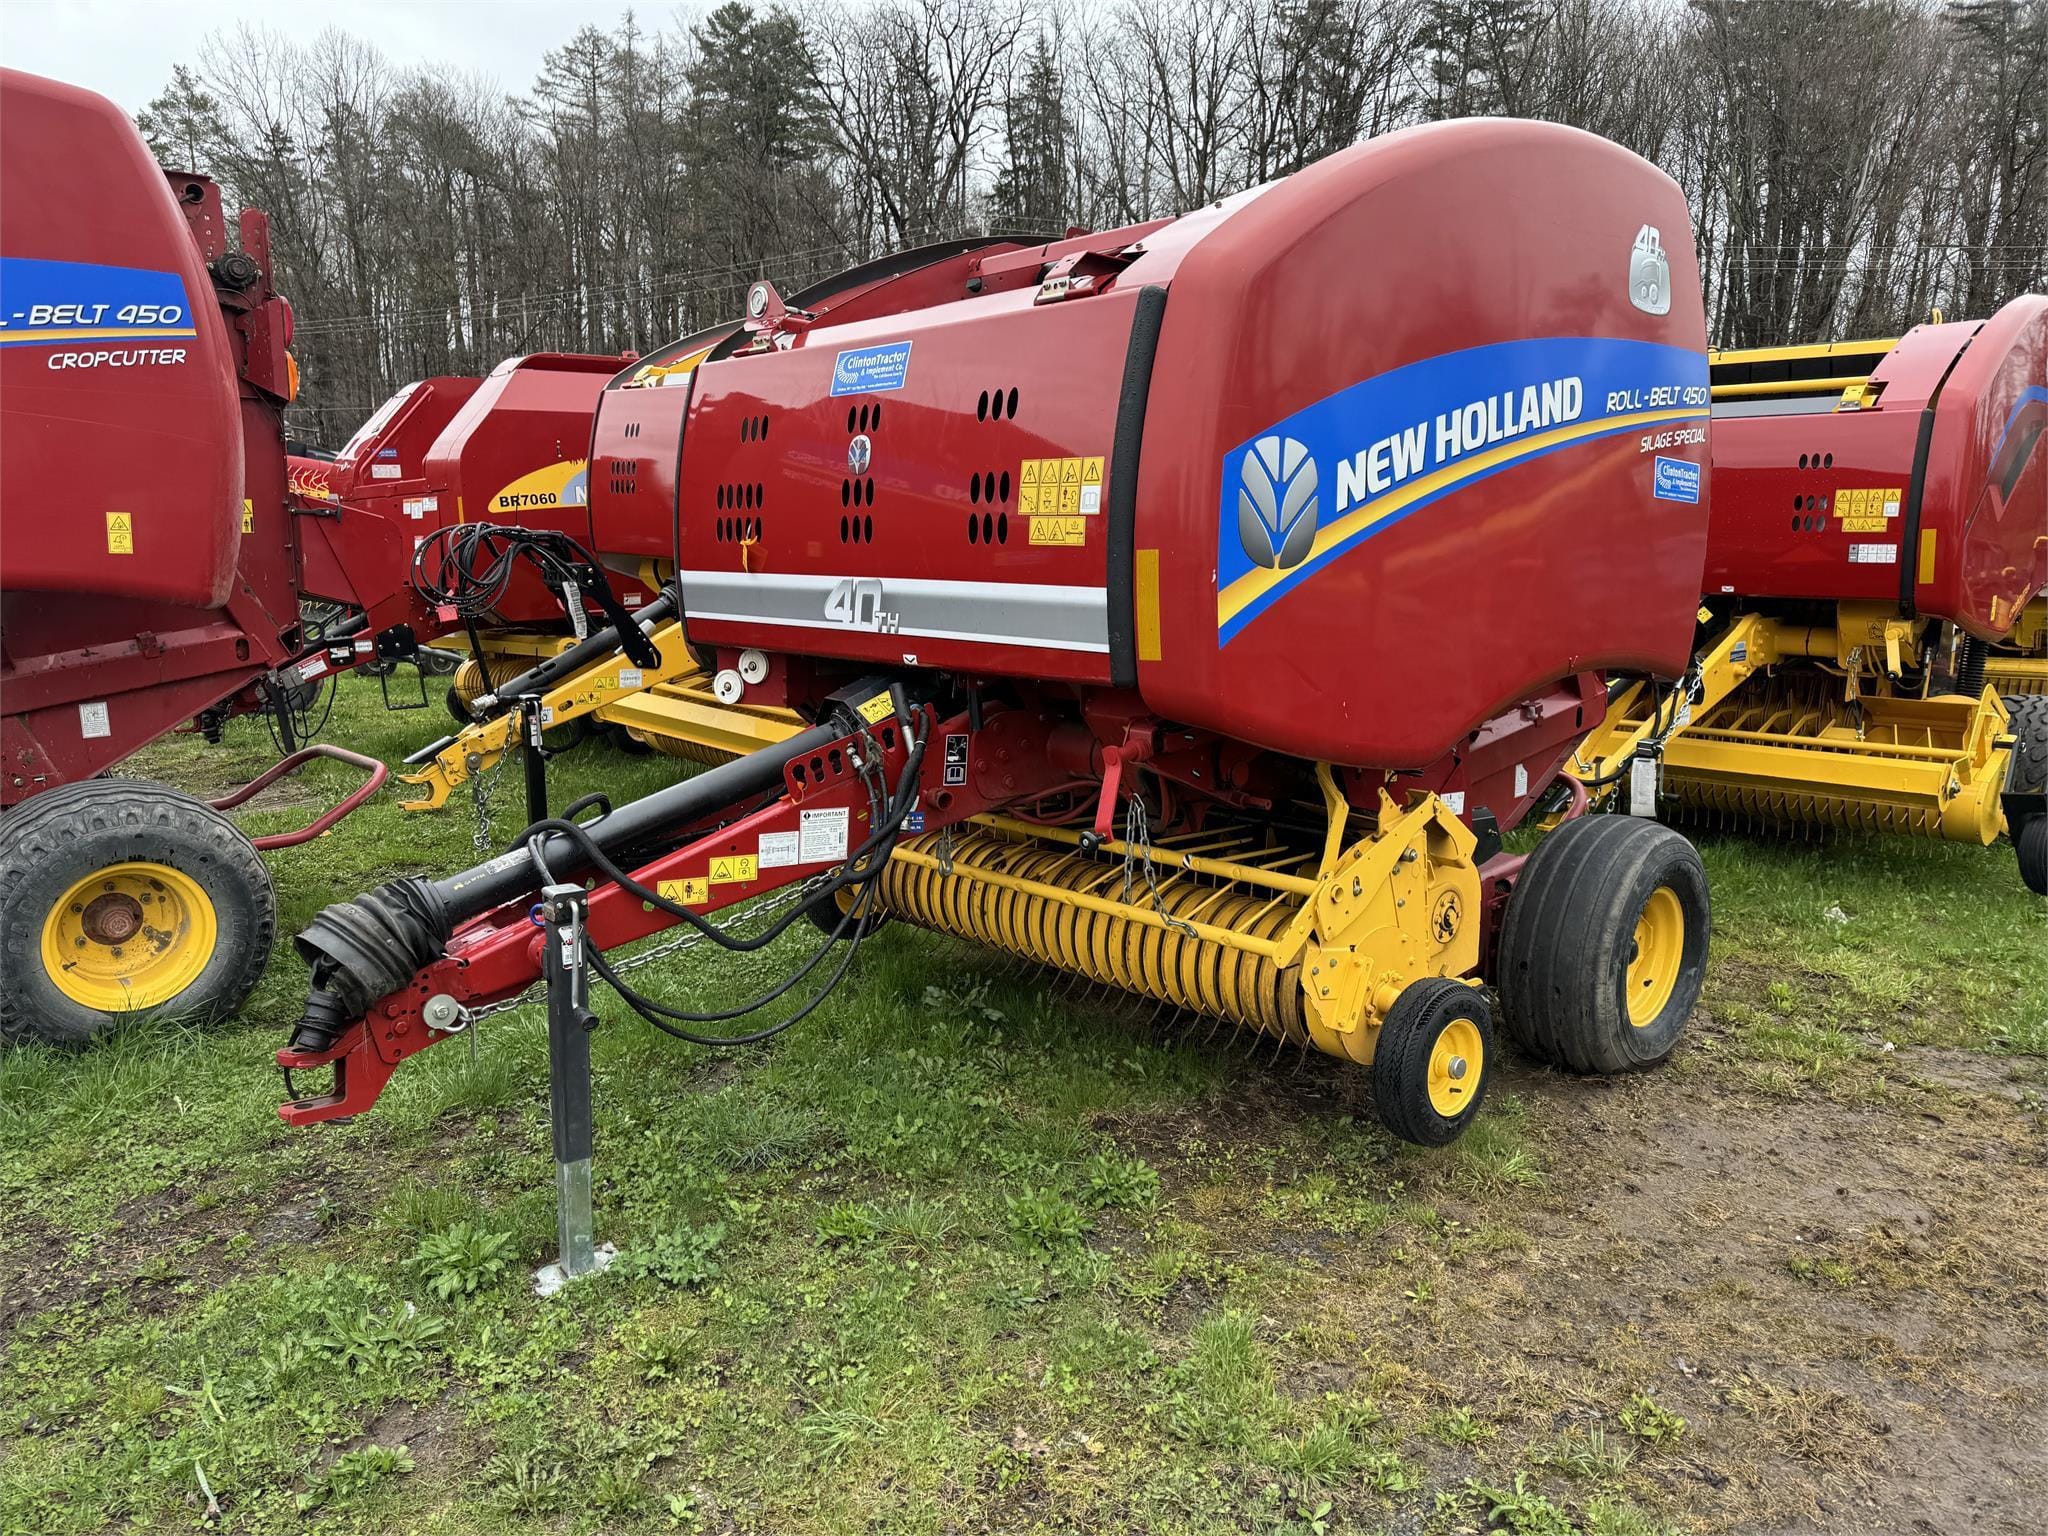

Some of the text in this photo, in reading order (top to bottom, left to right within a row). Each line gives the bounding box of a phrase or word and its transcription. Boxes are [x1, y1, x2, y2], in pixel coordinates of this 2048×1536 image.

[116, 304, 183, 325] 450
[48, 348, 187, 370] CROPCUTTER
[1682, 386, 1707, 405] 450
[1336, 376, 1584, 513] NEW HOLLAND
[1640, 427, 1706, 453] SILAGE SPECIAL
[499, 492, 557, 507] BR7060
[811, 810, 846, 819] IMPORTANT
